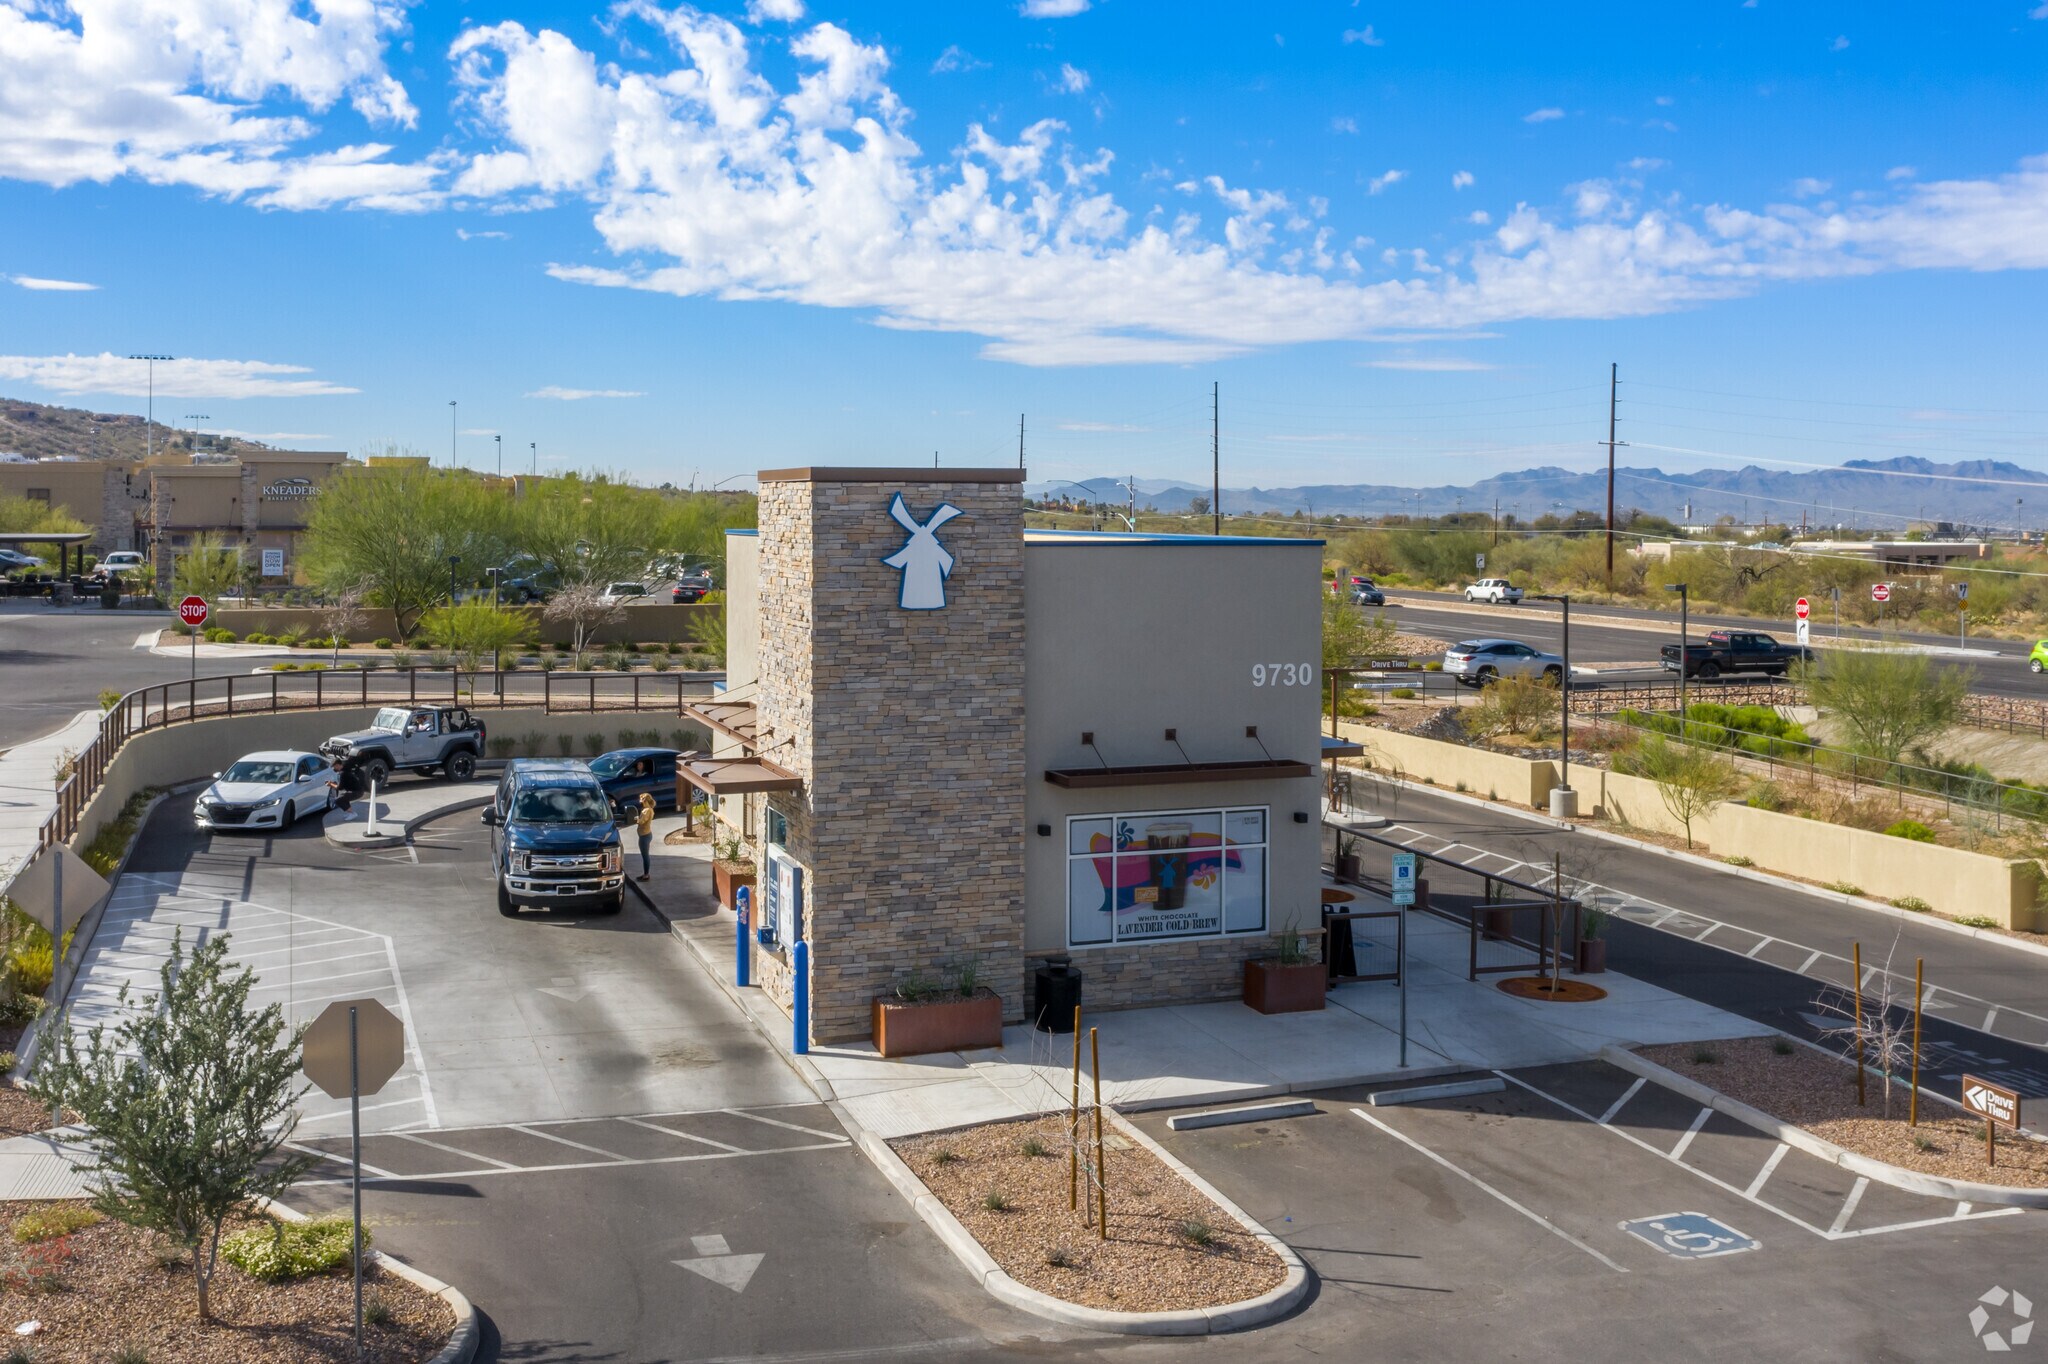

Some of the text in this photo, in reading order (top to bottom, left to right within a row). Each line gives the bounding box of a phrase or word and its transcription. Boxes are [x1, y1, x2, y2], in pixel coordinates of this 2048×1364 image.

[263, 486, 322, 495] KNEADERS
[181, 604, 206, 617] STOP
[1796, 604, 1809, 613] STOP
[1252, 662, 1312, 687] 9730
[1160, 912, 1199, 921] CHOCOLATE
[1118, 917, 1218, 935] LAVENDER COLD BREW
[1987, 1089, 2014, 1110] DRIVE
[1987, 1102, 2010, 1121] THRU
